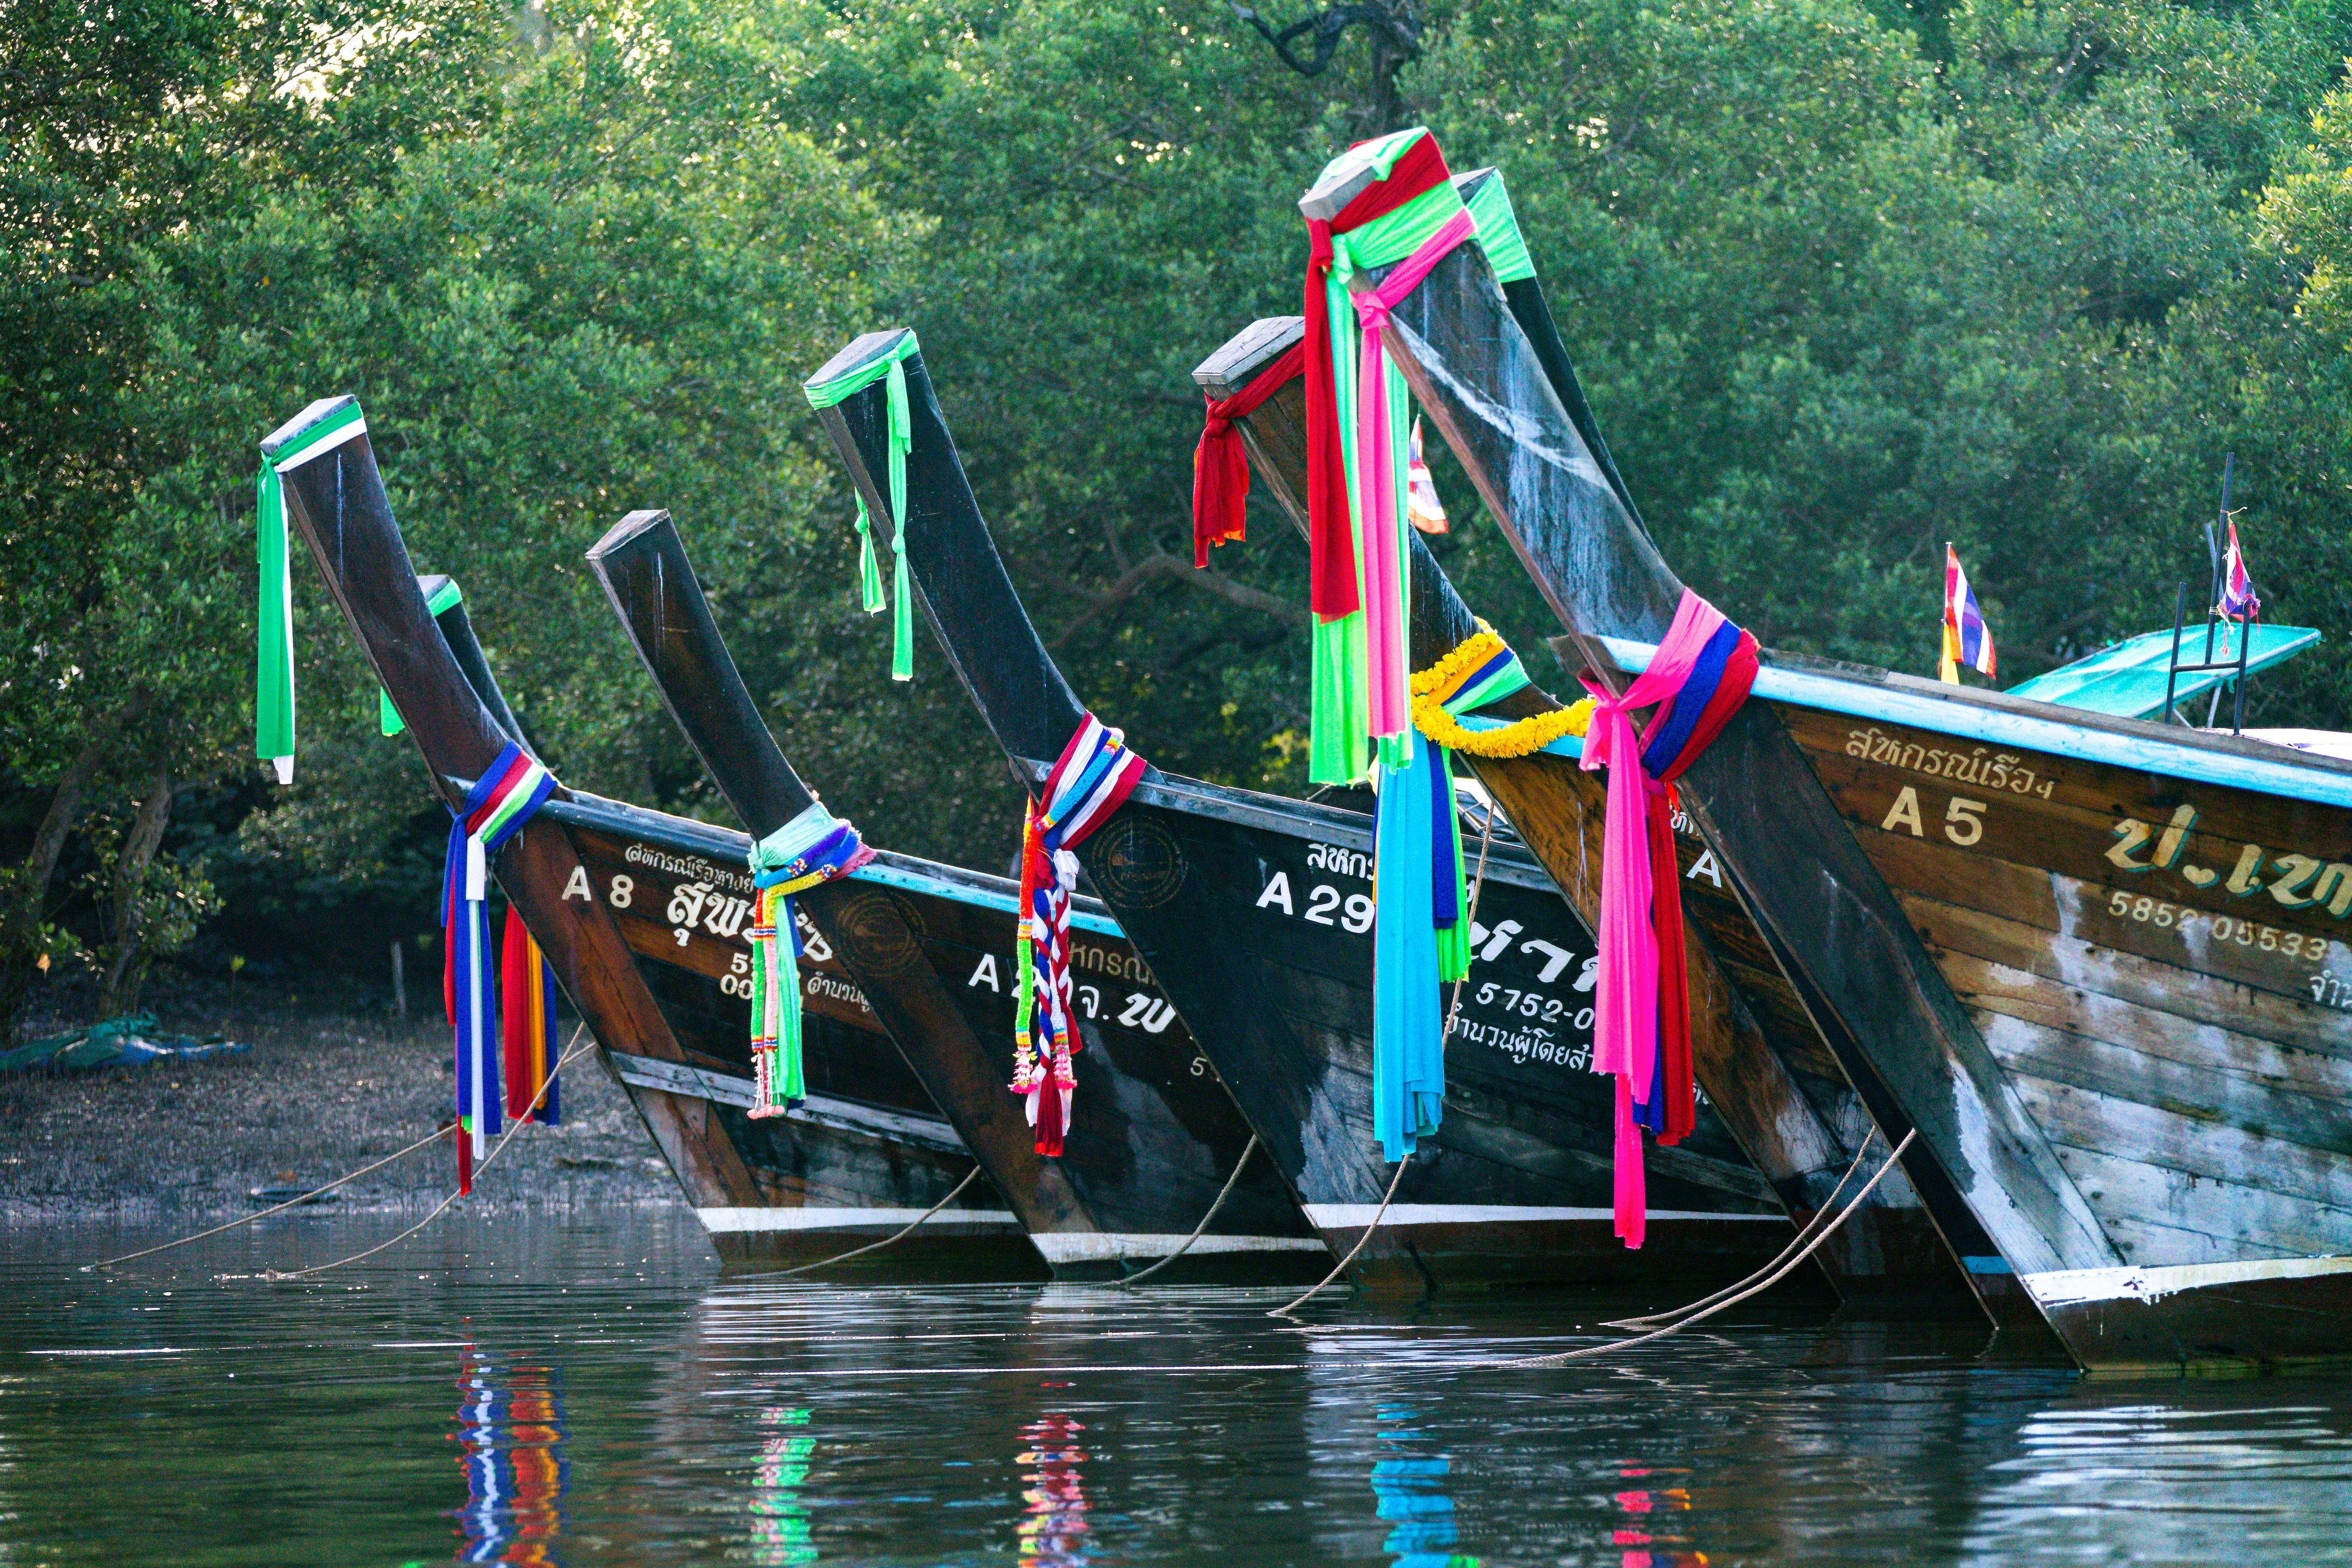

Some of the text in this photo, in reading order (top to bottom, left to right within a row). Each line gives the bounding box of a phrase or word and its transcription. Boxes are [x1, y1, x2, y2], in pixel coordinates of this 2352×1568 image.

[1882, 786, 1987, 846] A 5
[562, 865, 634, 908] A 8
[1686, 849, 1722, 888] A
[1255, 871, 1375, 933] A 29
[968, 954, 999, 993] A
